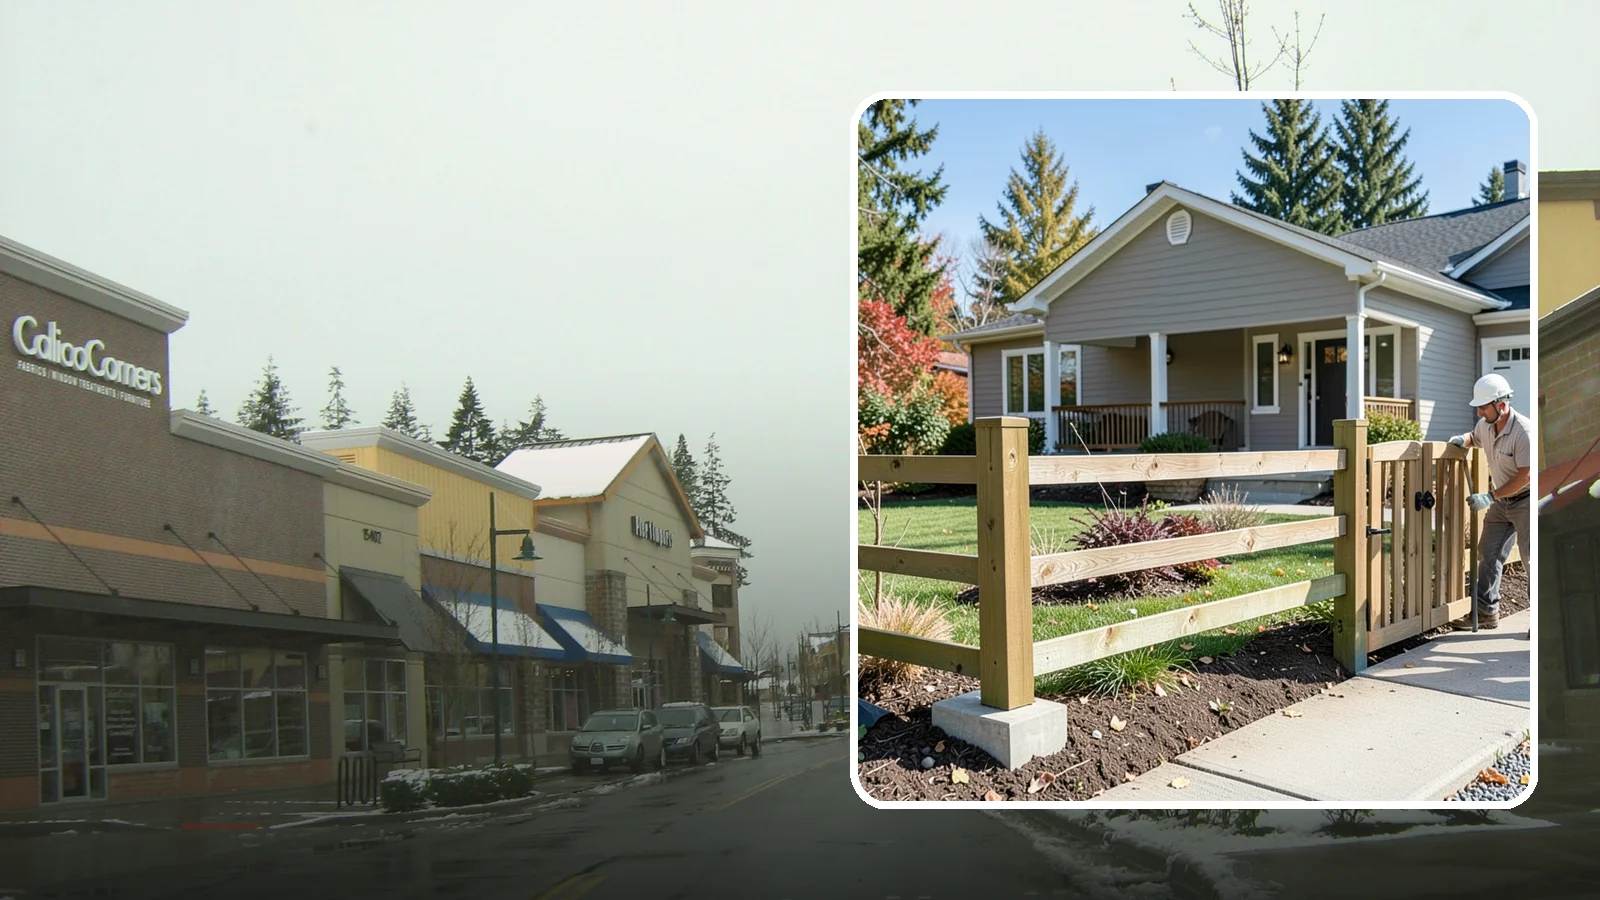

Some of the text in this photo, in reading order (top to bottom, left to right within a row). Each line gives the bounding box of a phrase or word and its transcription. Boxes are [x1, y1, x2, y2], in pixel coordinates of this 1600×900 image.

[17, 360, 151, 408] FABRICS WINDOW TREATMENTS FURNITURE
